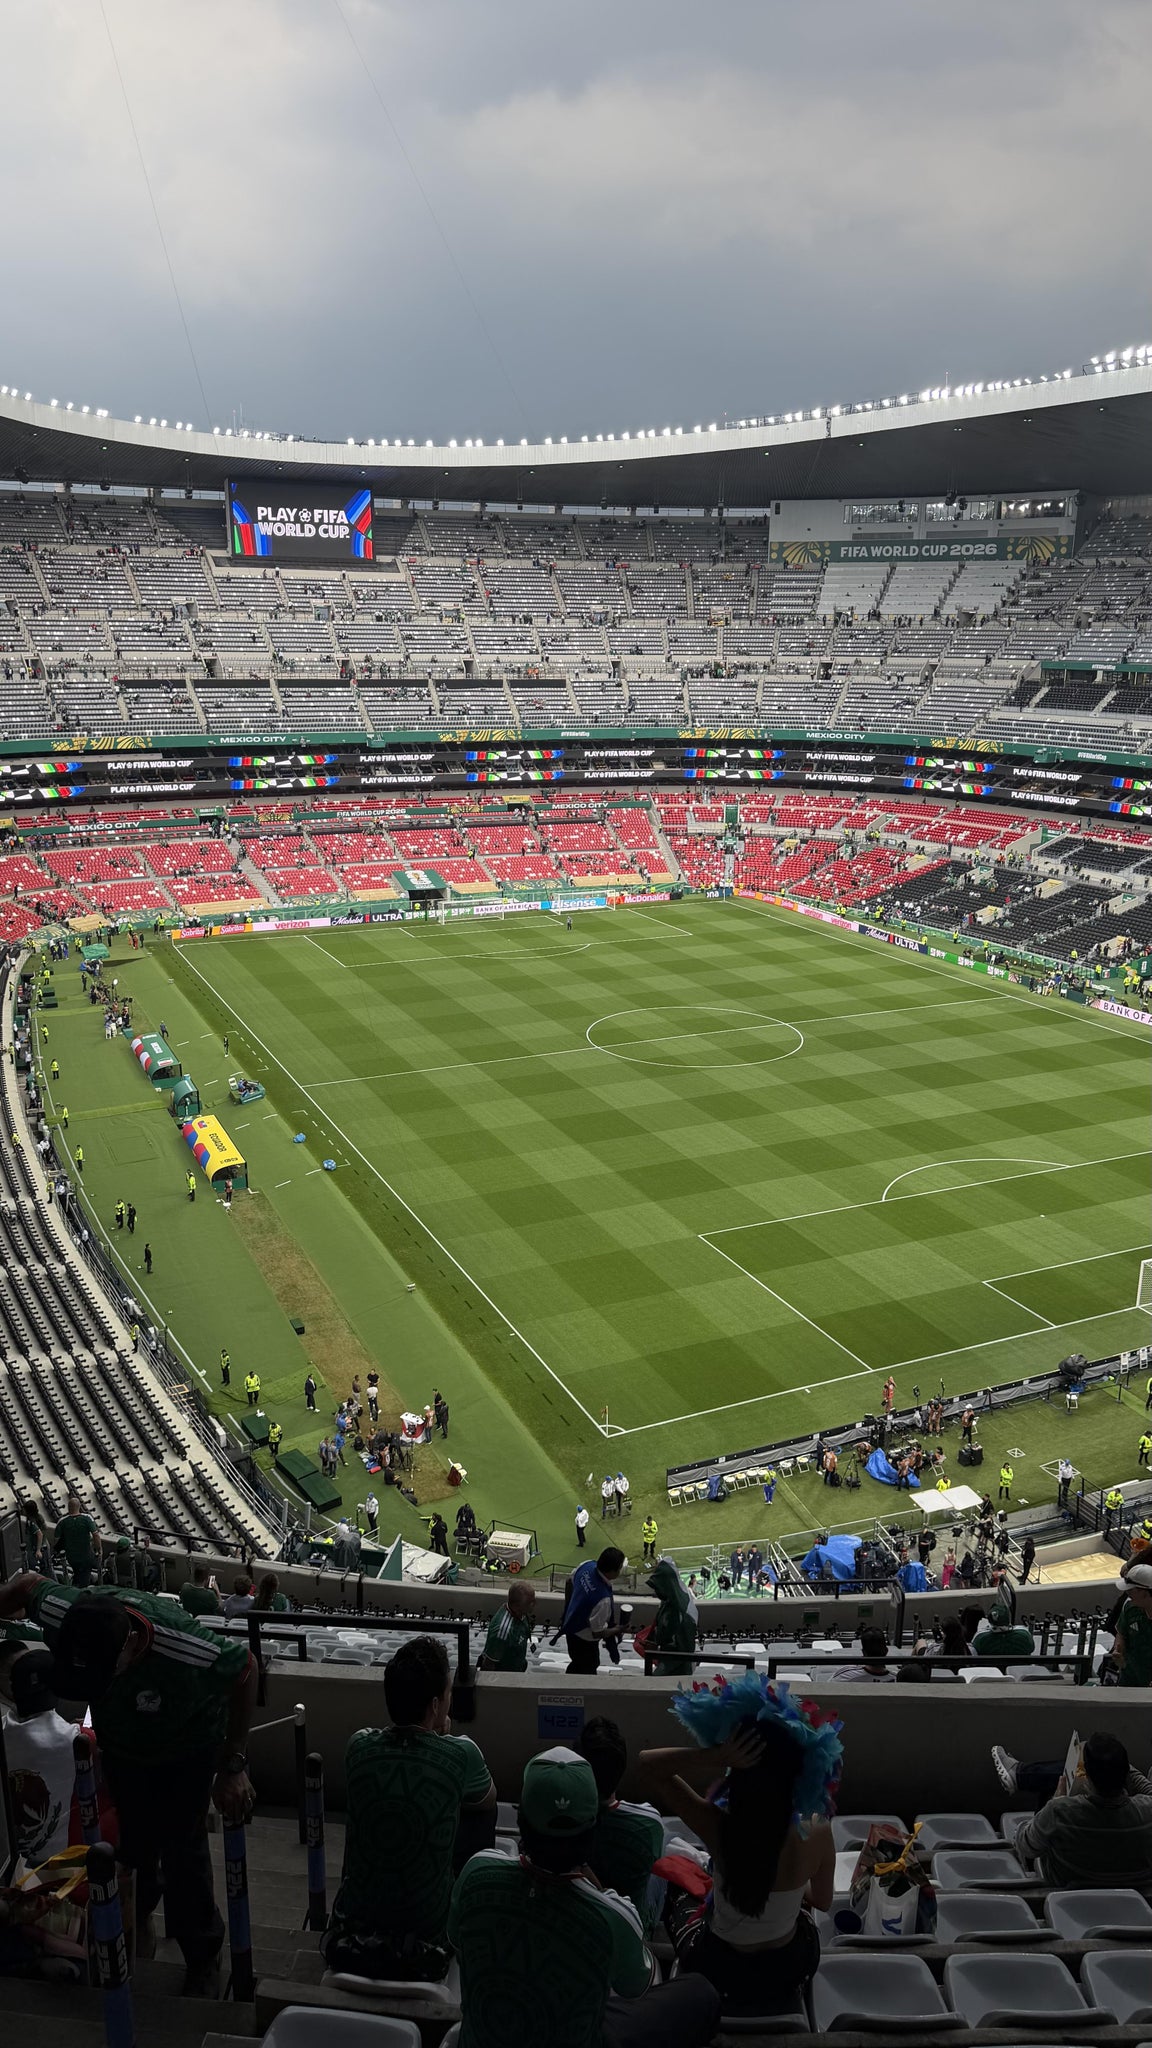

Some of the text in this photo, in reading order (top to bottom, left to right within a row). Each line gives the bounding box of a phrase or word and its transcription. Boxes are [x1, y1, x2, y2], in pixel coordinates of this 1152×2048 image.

[257, 506, 349, 524] PLAY FIFA
[258, 521, 316, 537] WORLD
[840, 542, 997, 558] FIFA WORLD CUP 2026
[219, 735, 287, 745] MEXICO CITY
[806, 731, 866, 740] MEXICO CITY
[382, 754, 396, 762] FIFA
[107, 762, 126, 770] PLAY
[133, 761, 150, 769] FIFA
[150, 760, 176, 768] WORLD
[1013, 768, 1028, 776] PLAY
[1033, 770, 1046, 778] FIFA
[1046, 771, 1067, 780] WORLD
[110, 786, 128, 794] PLAY
[136, 785, 152, 793] FIFA
[152, 784, 178, 792] WORLD
[1011, 791, 1026, 799] PLAY
[1031, 793, 1044, 801] FIFA
[1044, 795, 1065, 804] WORLD
[551, 803, 587, 811] MEXICO
[69, 821, 140, 833] MEXICO CITY
[624, 892, 670, 903] McDonald's
[475, 906, 493, 914] BANK
[504, 903, 533, 911] AMERICA
[804, 908, 823, 920] verizon
[274, 920, 310, 930] verizon
[331, 916, 364, 927] Michelob
[372, 912, 403, 923] ULTRA
[830, 917, 852, 929] verizon
[220, 925, 245, 935] Sabritas
[865, 928, 920, 952] Michelob ULTRA
[1103, 1002, 1130, 1017] BANK
[1133, 1011, 1146, 1021] OF
[209, 1133, 227, 1152] ECUADOR
[544, 1714, 579, 1728] 422
[306, 1816, 320, 1847] 422
[226, 1859, 243, 1898] 422
